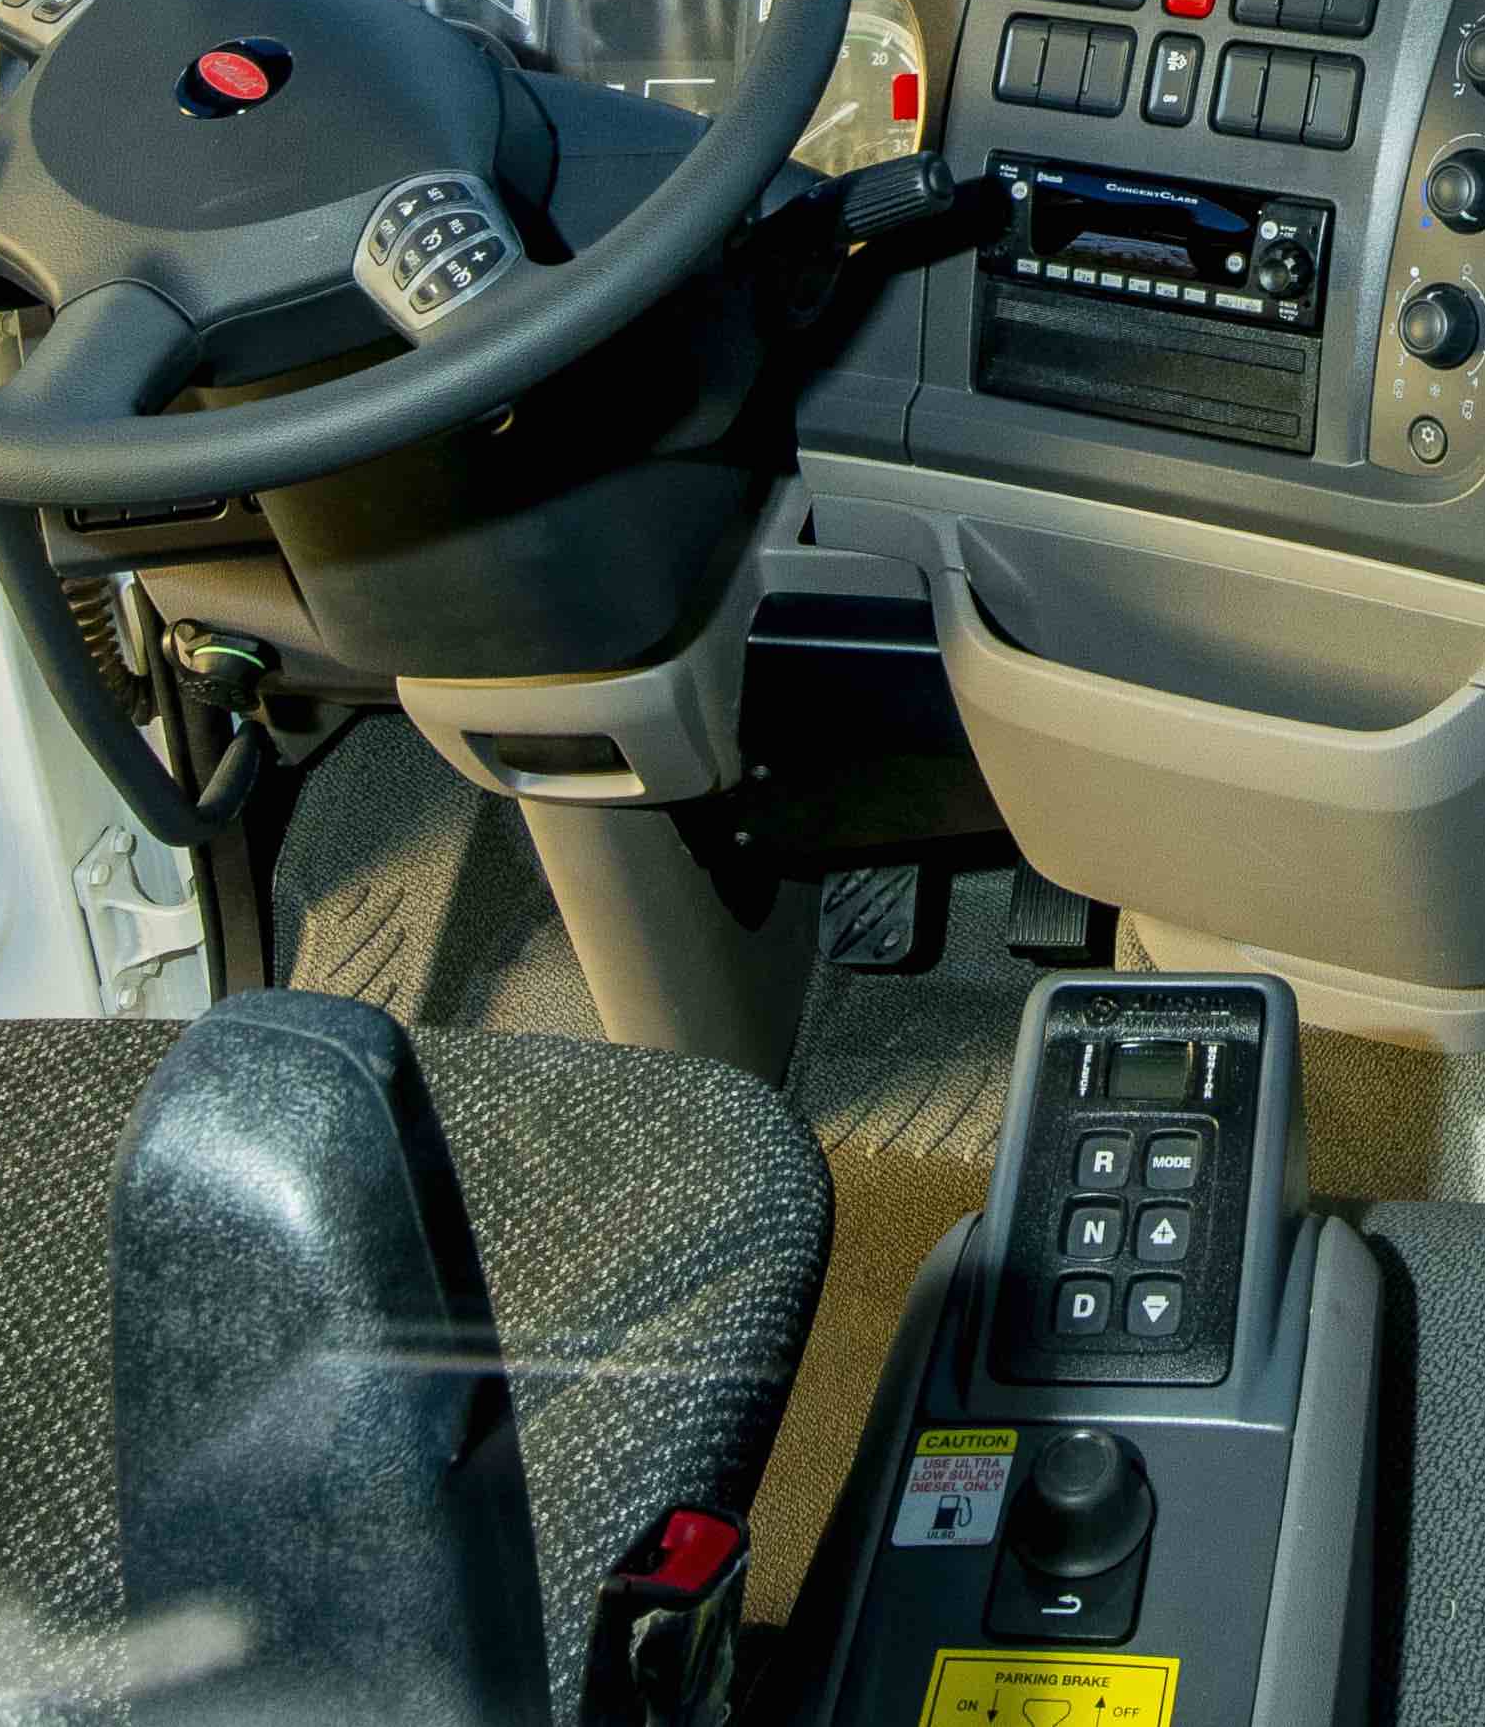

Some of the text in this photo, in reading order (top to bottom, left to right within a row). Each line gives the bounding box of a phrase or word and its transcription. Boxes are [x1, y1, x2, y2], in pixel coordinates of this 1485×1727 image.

[871, 52, 889, 66] 20
[892, 139, 910, 153] 35
[1093, 1150, 1114, 1173] R
[1152, 1156, 1192, 1169] MODE
[1083, 1220, 1105, 1244] N
[1072, 1294, 1095, 1318] D
[926, 1434, 1009, 1449] CAUTION
[923, 1458, 1000, 1469] USE ULTRA
[913, 1471, 947, 1481] LOW
[962, 1482, 1004, 1491] ONLY
[995, 1672, 1111, 1689] PARKING BRAKE
[956, 1700, 978, 1712] ON
[1113, 1706, 1140, 1719] OFF
